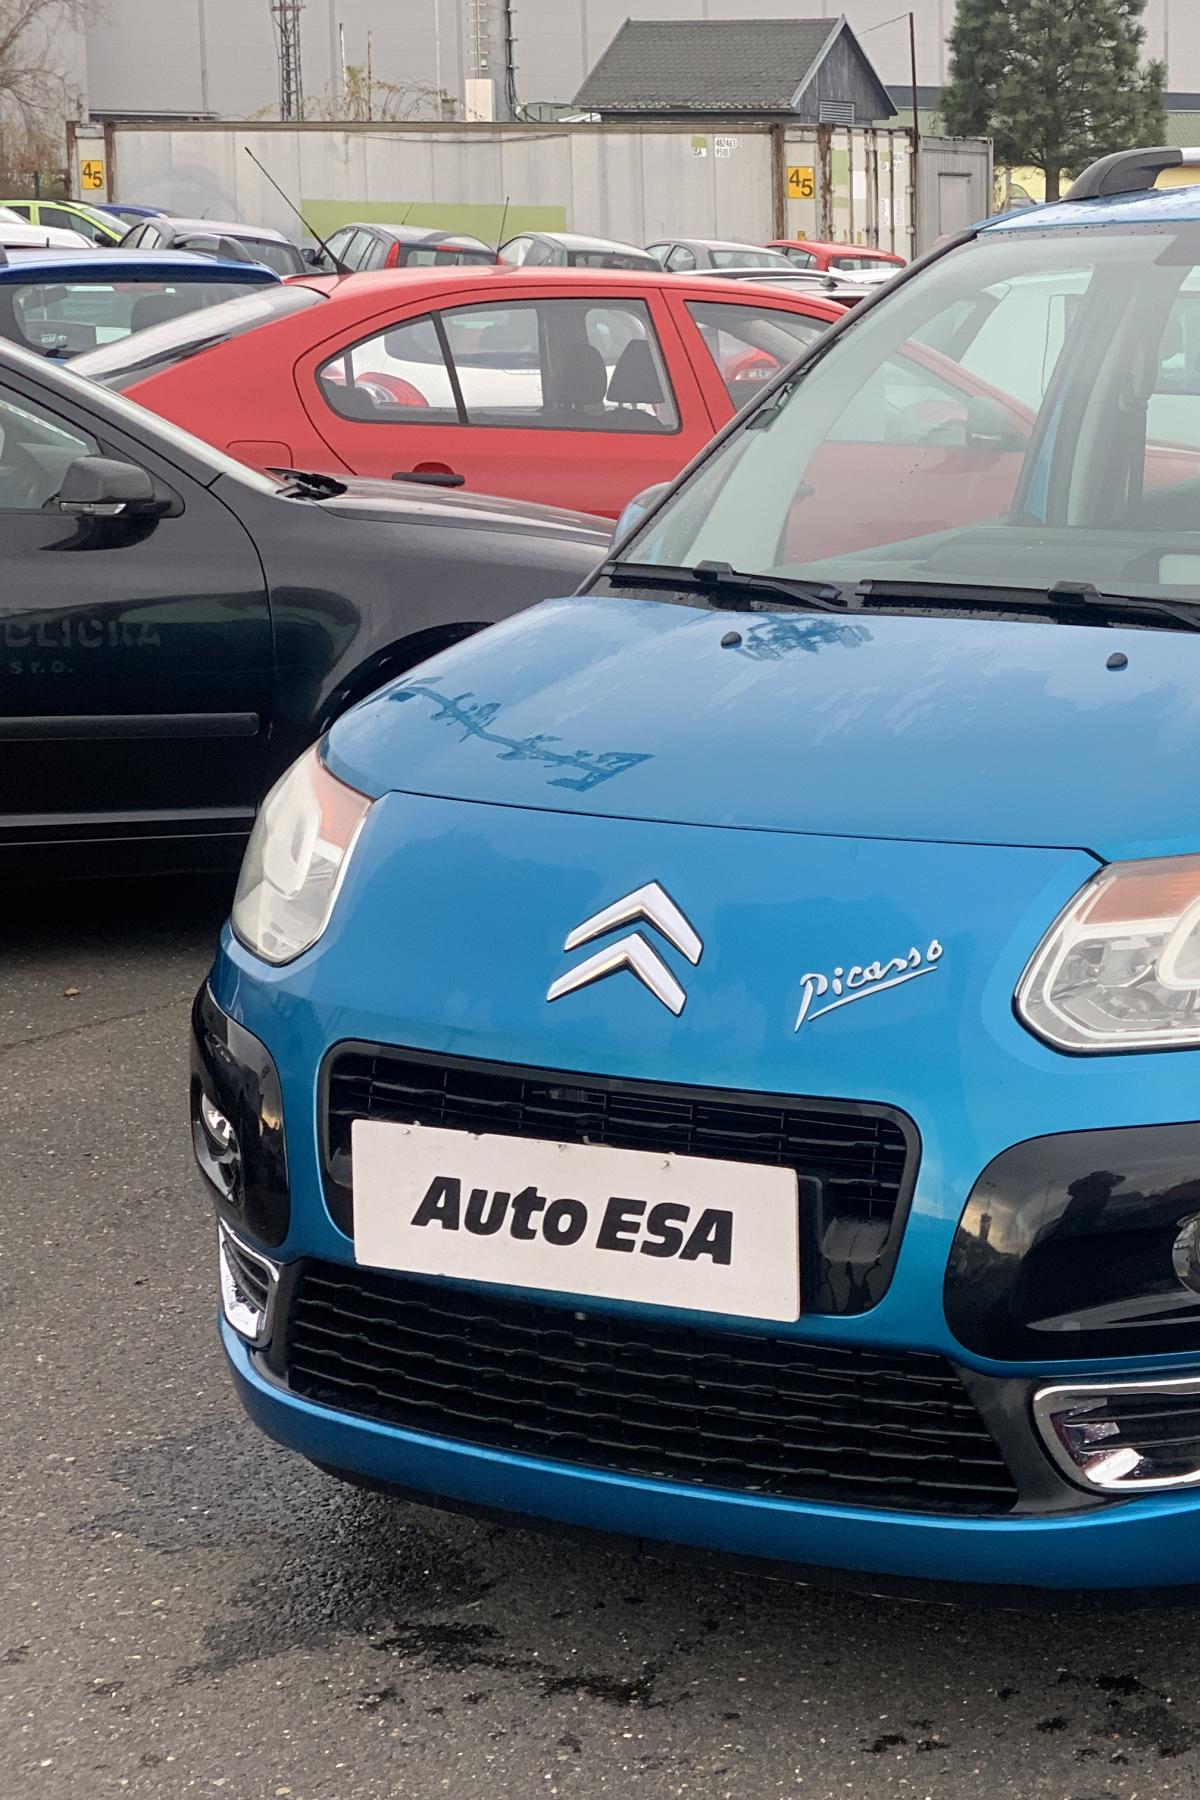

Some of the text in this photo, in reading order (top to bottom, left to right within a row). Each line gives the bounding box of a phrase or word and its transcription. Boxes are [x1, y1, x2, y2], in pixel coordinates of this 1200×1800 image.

[83, 162, 103, 188] 45
[789, 168, 813, 197] 45
[794, 939, 944, 1033] Picasso
[410, 1176, 734, 1265] Auto ESA
